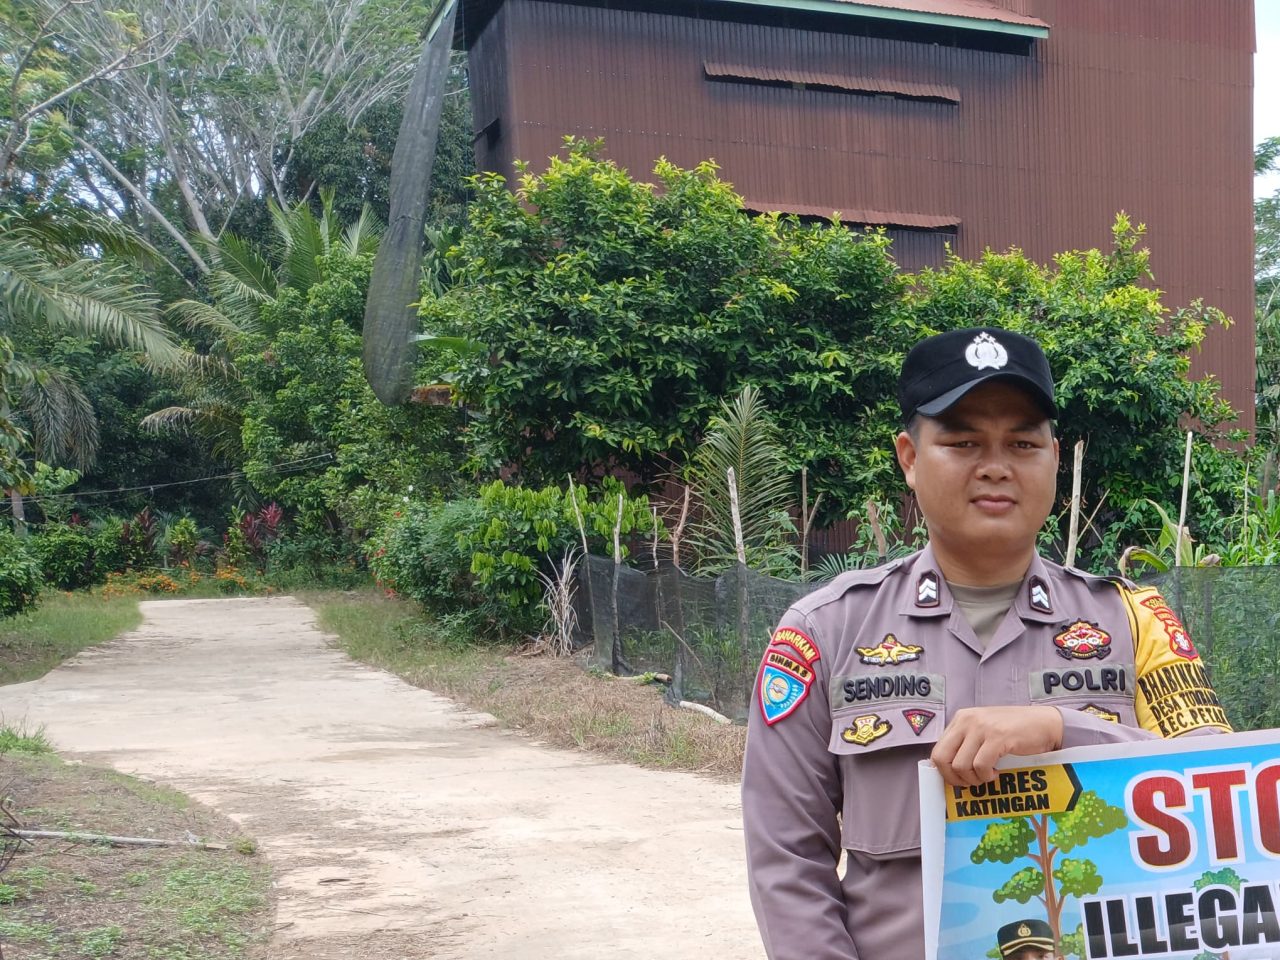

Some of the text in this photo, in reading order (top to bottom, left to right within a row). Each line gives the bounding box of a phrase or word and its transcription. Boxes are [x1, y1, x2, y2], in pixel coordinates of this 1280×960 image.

[769, 653, 809, 678] BINMAS
[843, 674, 932, 703] SENDING
[1042, 668, 1126, 695] POLRI
[1149, 696, 1182, 722] DESA
[955, 793, 1050, 818] KATINGAN
